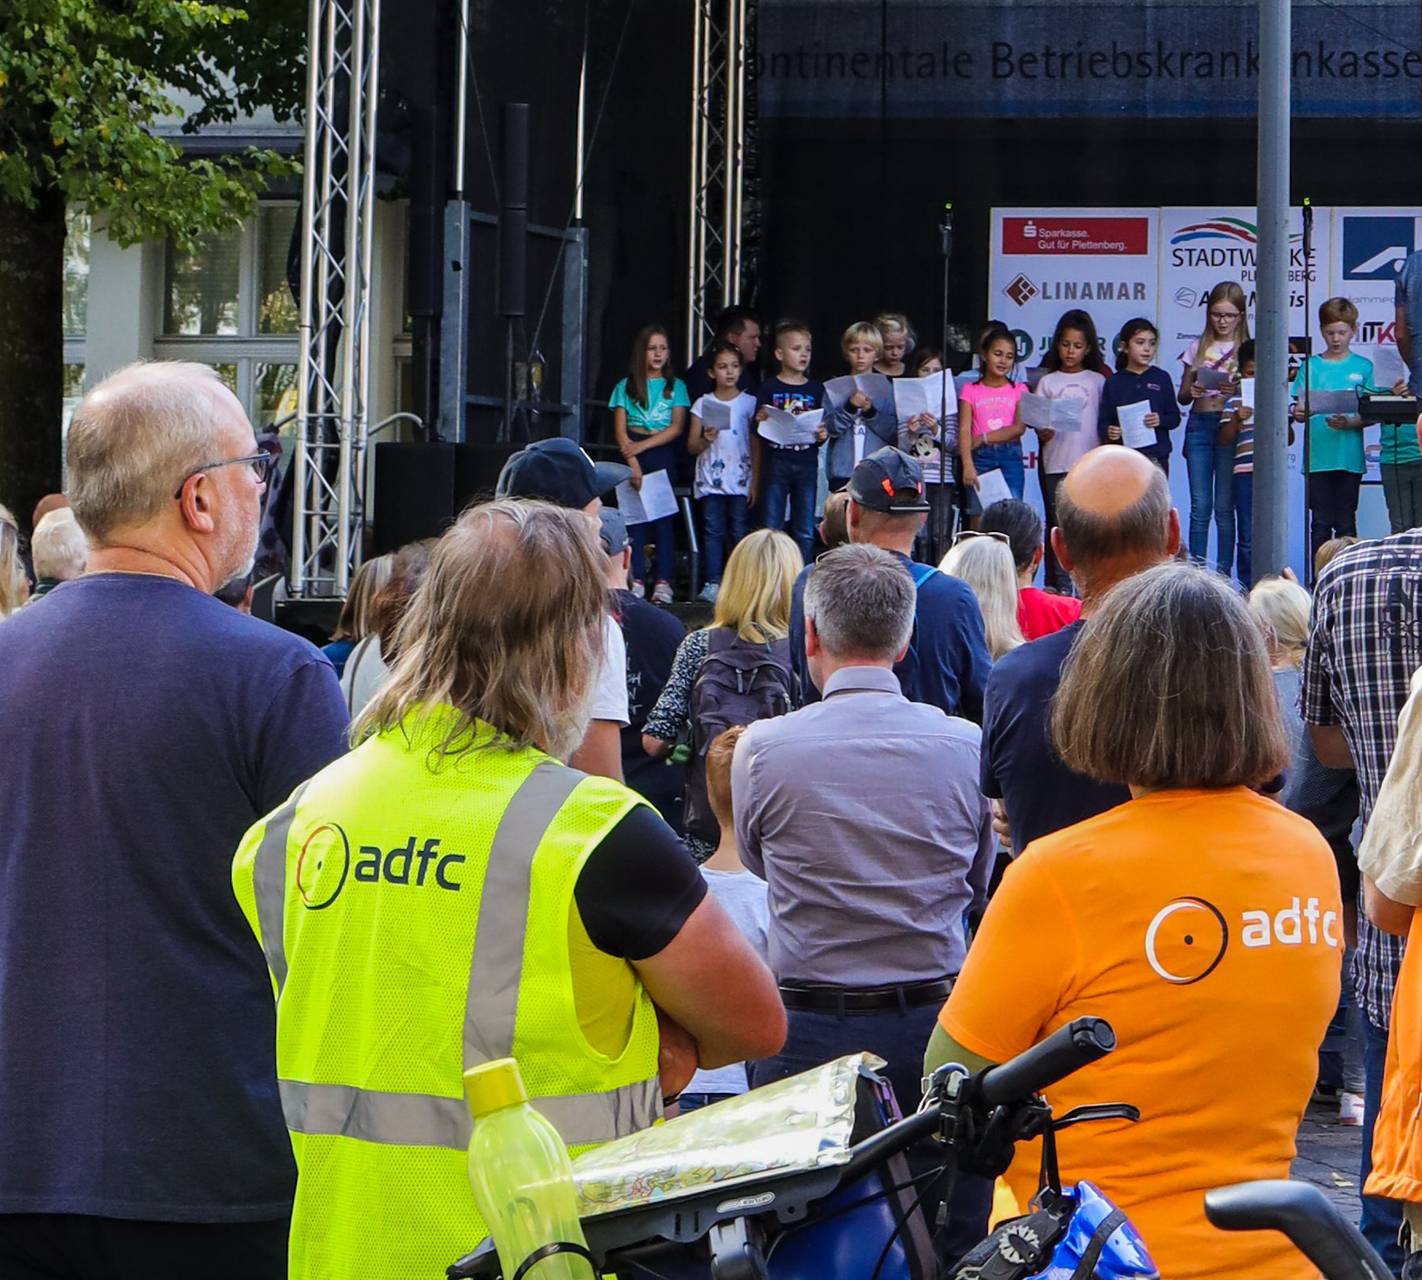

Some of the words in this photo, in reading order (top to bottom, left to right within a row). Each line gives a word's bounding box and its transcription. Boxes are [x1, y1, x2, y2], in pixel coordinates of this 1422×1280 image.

[757, 42, 974, 79] ontinentale
[1038, 228, 1091, 239] Sparkasse.
[1038, 240, 1055, 250] Gut
[1057, 240, 1070, 250] für
[1071, 240, 1128, 252] Plettenberg.
[1172, 248, 1316, 267] STADTWKE
[1041, 281, 1146, 300] LINAMAR
[354, 836, 467, 892] adfc
[1241, 896, 1339, 948] adfc
